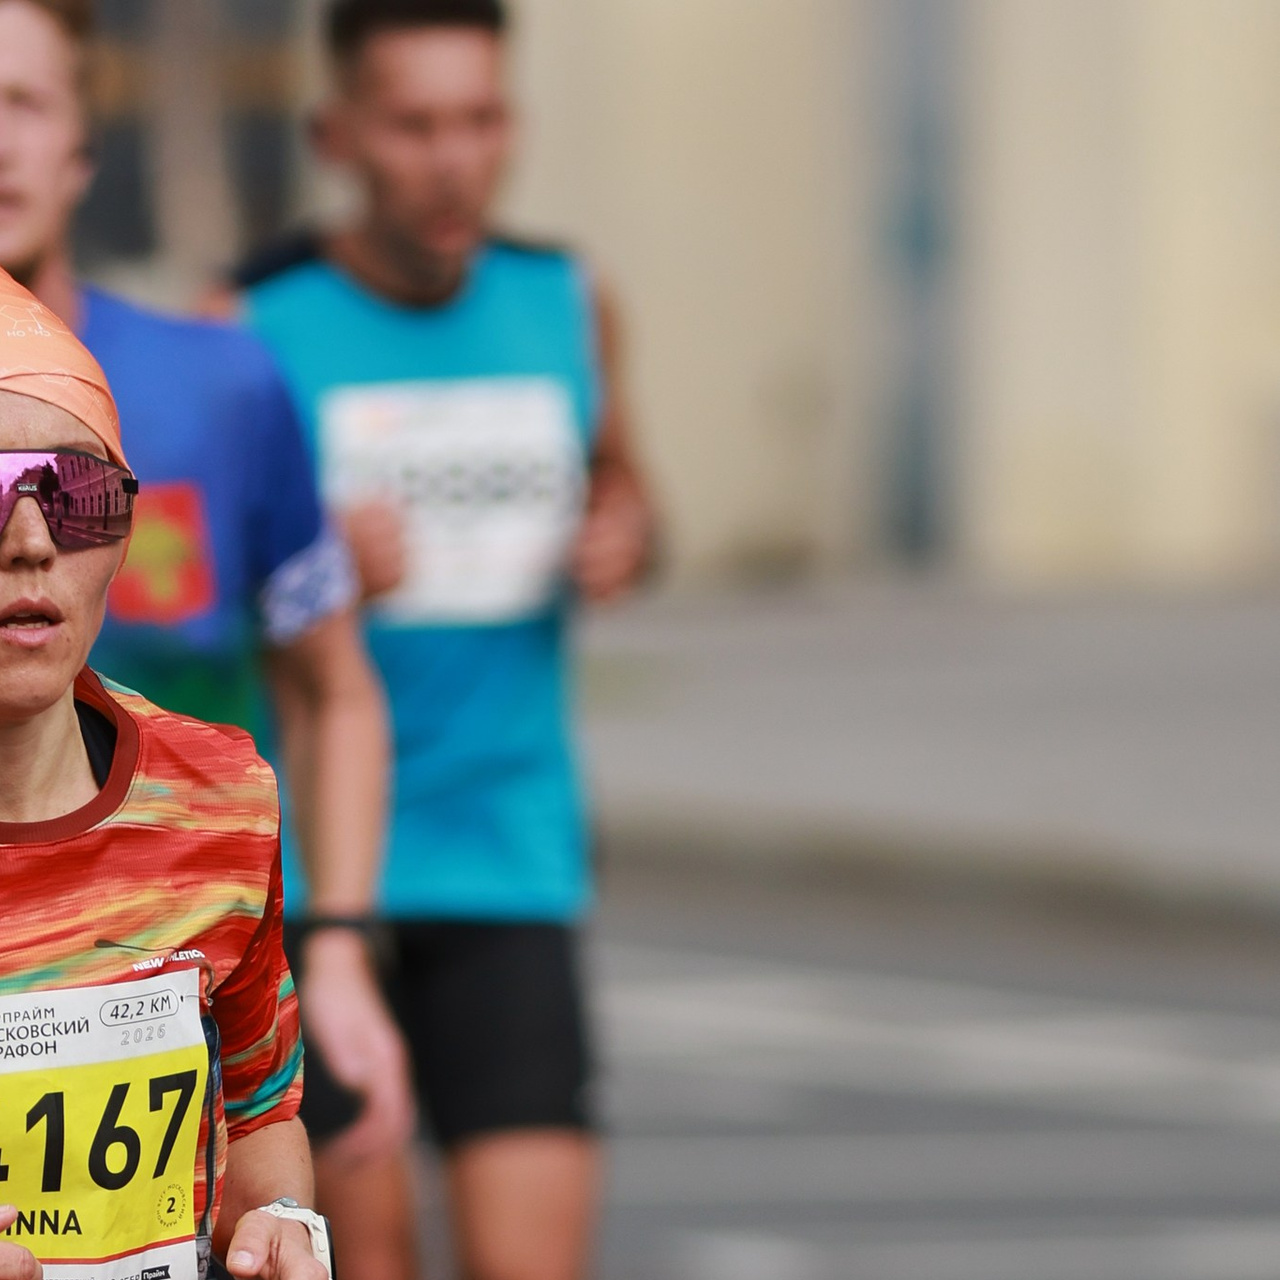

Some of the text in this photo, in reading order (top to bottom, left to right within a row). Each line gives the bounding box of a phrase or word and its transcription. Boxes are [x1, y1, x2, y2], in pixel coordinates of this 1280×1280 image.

[132, 957, 165, 971] NEW
[110, 1001, 144, 1019] 42,2
[120, 1023, 166, 1046] 2026
[167, 1197, 176, 1214] 2
[143, 1270, 166, 1280] Прайм
